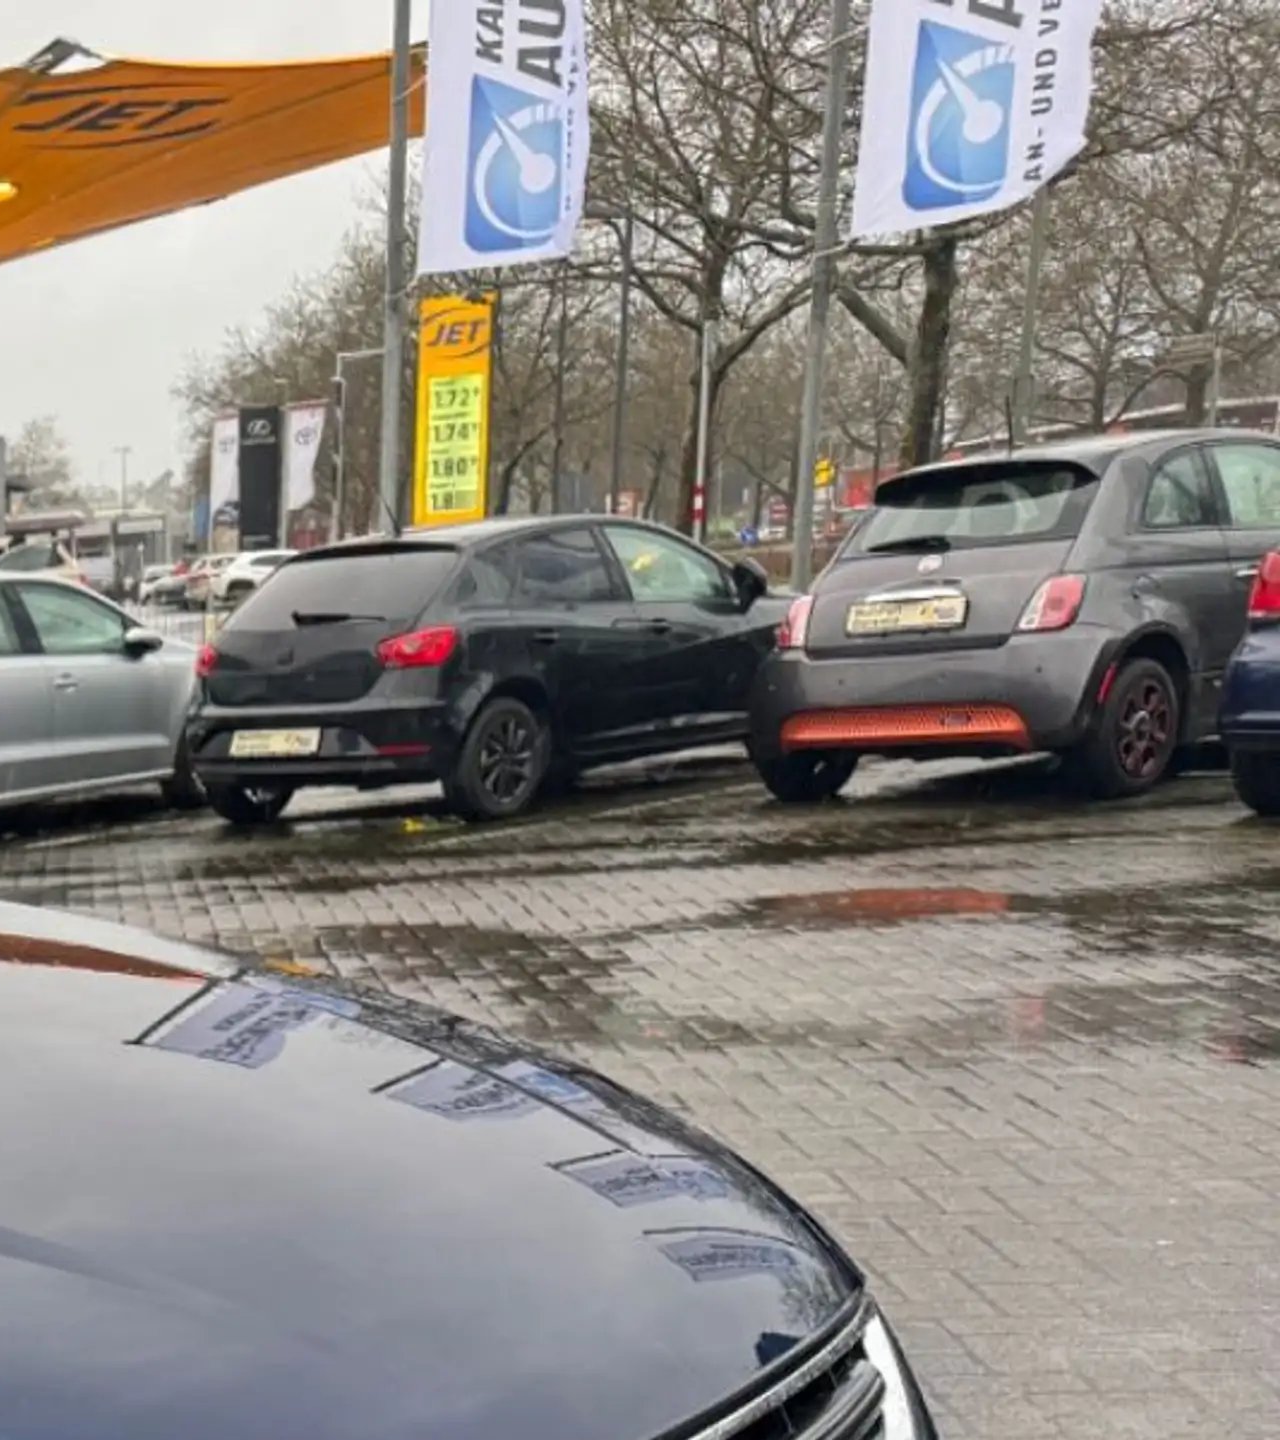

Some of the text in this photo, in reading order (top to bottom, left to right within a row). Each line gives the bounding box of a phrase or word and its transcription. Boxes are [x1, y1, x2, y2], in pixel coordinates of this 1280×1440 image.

[476, 0, 503, 63] KA
[1030, 48, 1058, 117] UND
[13, 97, 233, 132] JET
[427, 319, 487, 347] JET
